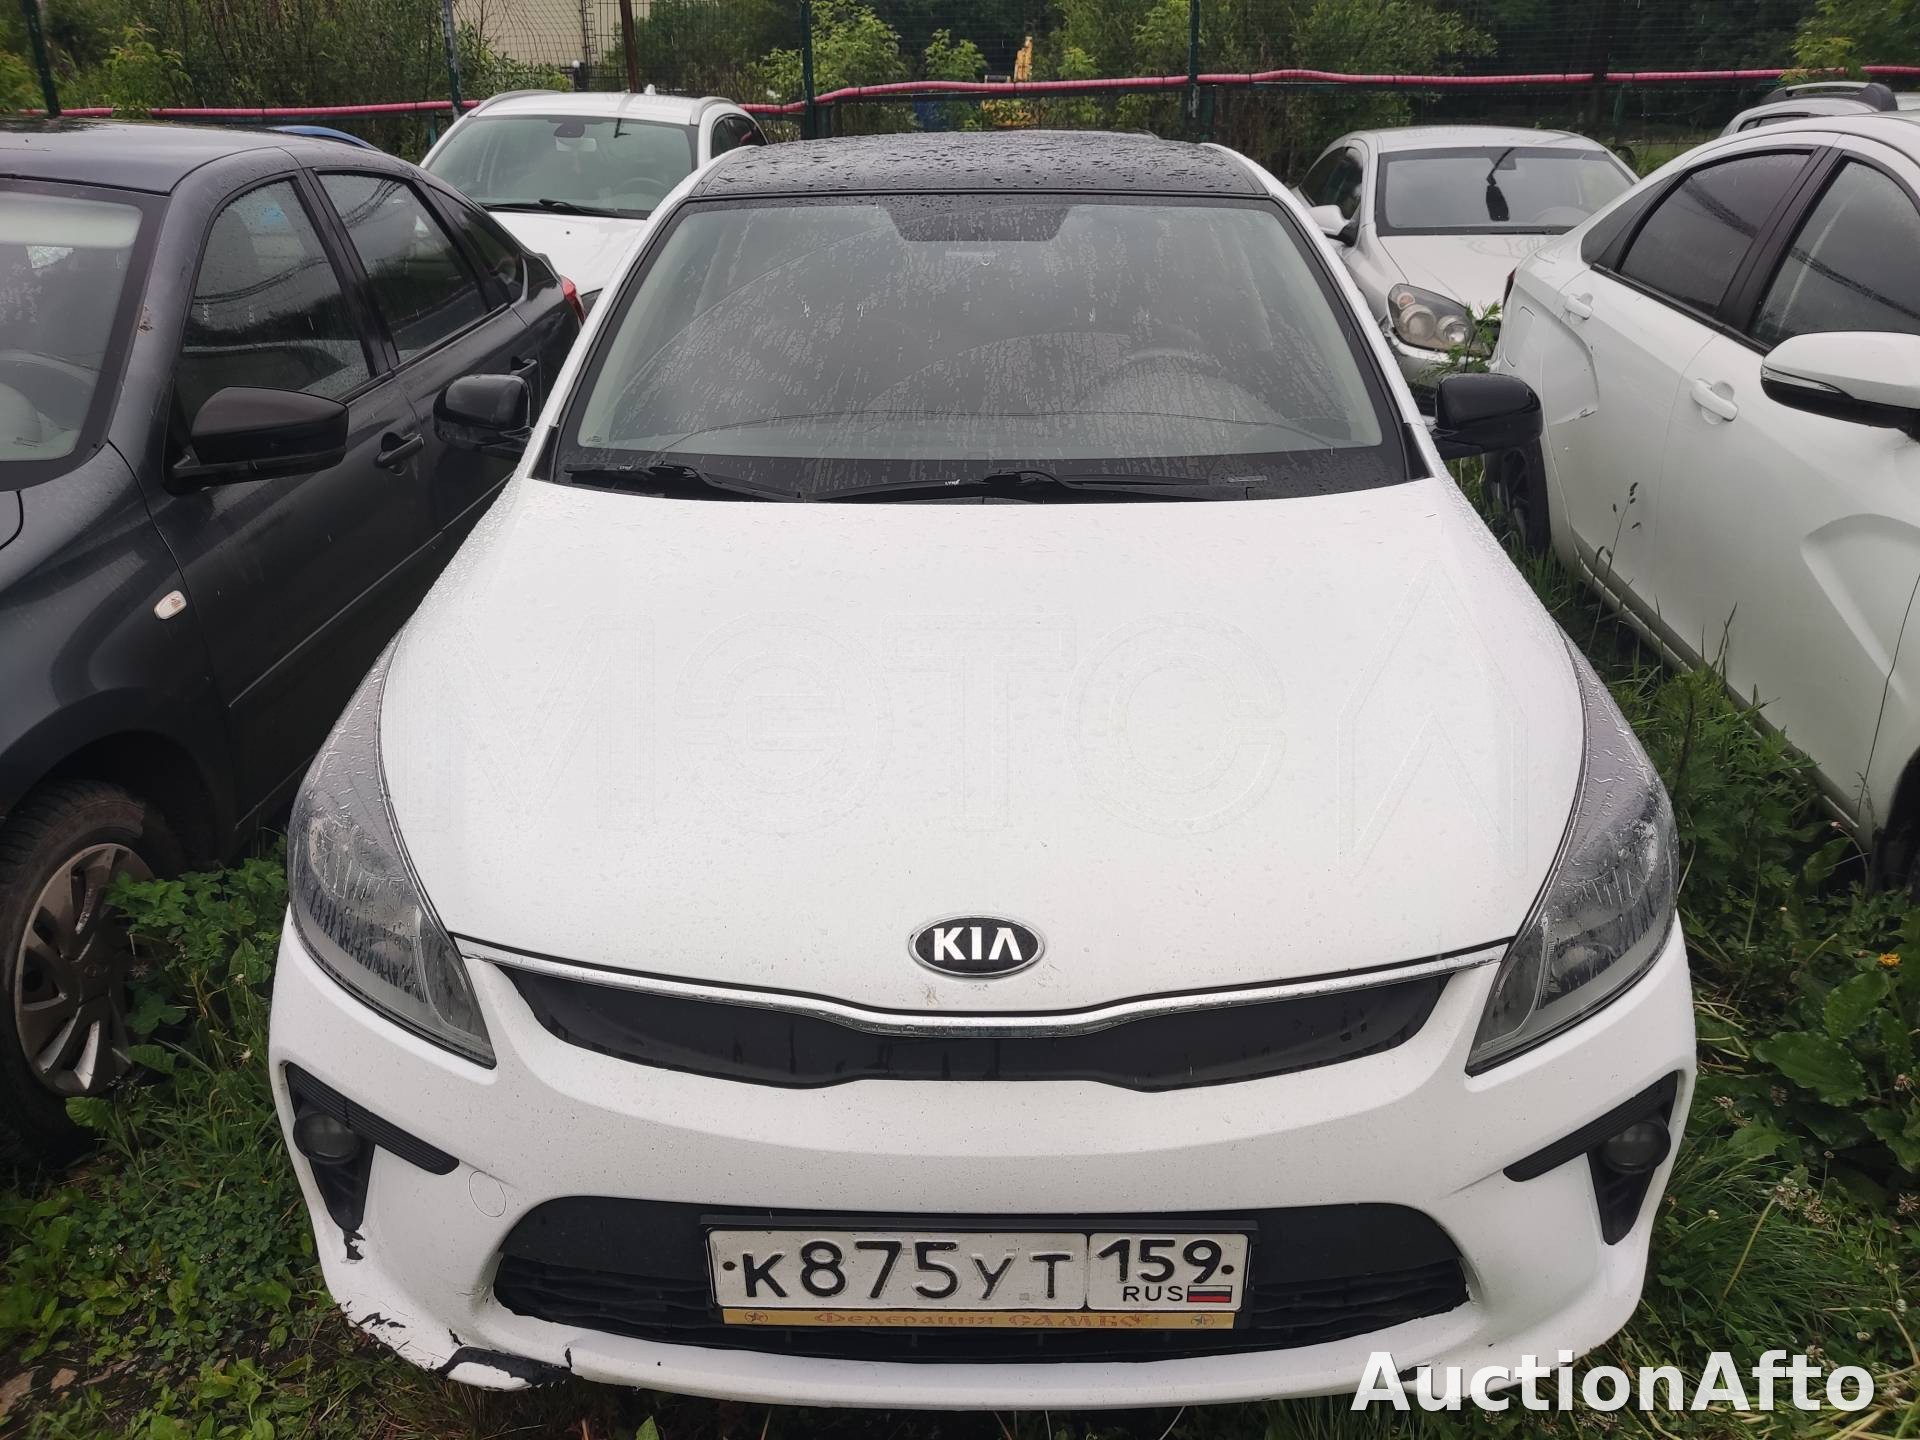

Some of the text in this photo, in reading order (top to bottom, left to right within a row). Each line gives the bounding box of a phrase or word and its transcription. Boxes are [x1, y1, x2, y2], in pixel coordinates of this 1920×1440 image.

[933, 926, 1023, 961] KIA
[1096, 1237, 1223, 1284] 159
[1123, 1285, 1184, 1303] RUS
